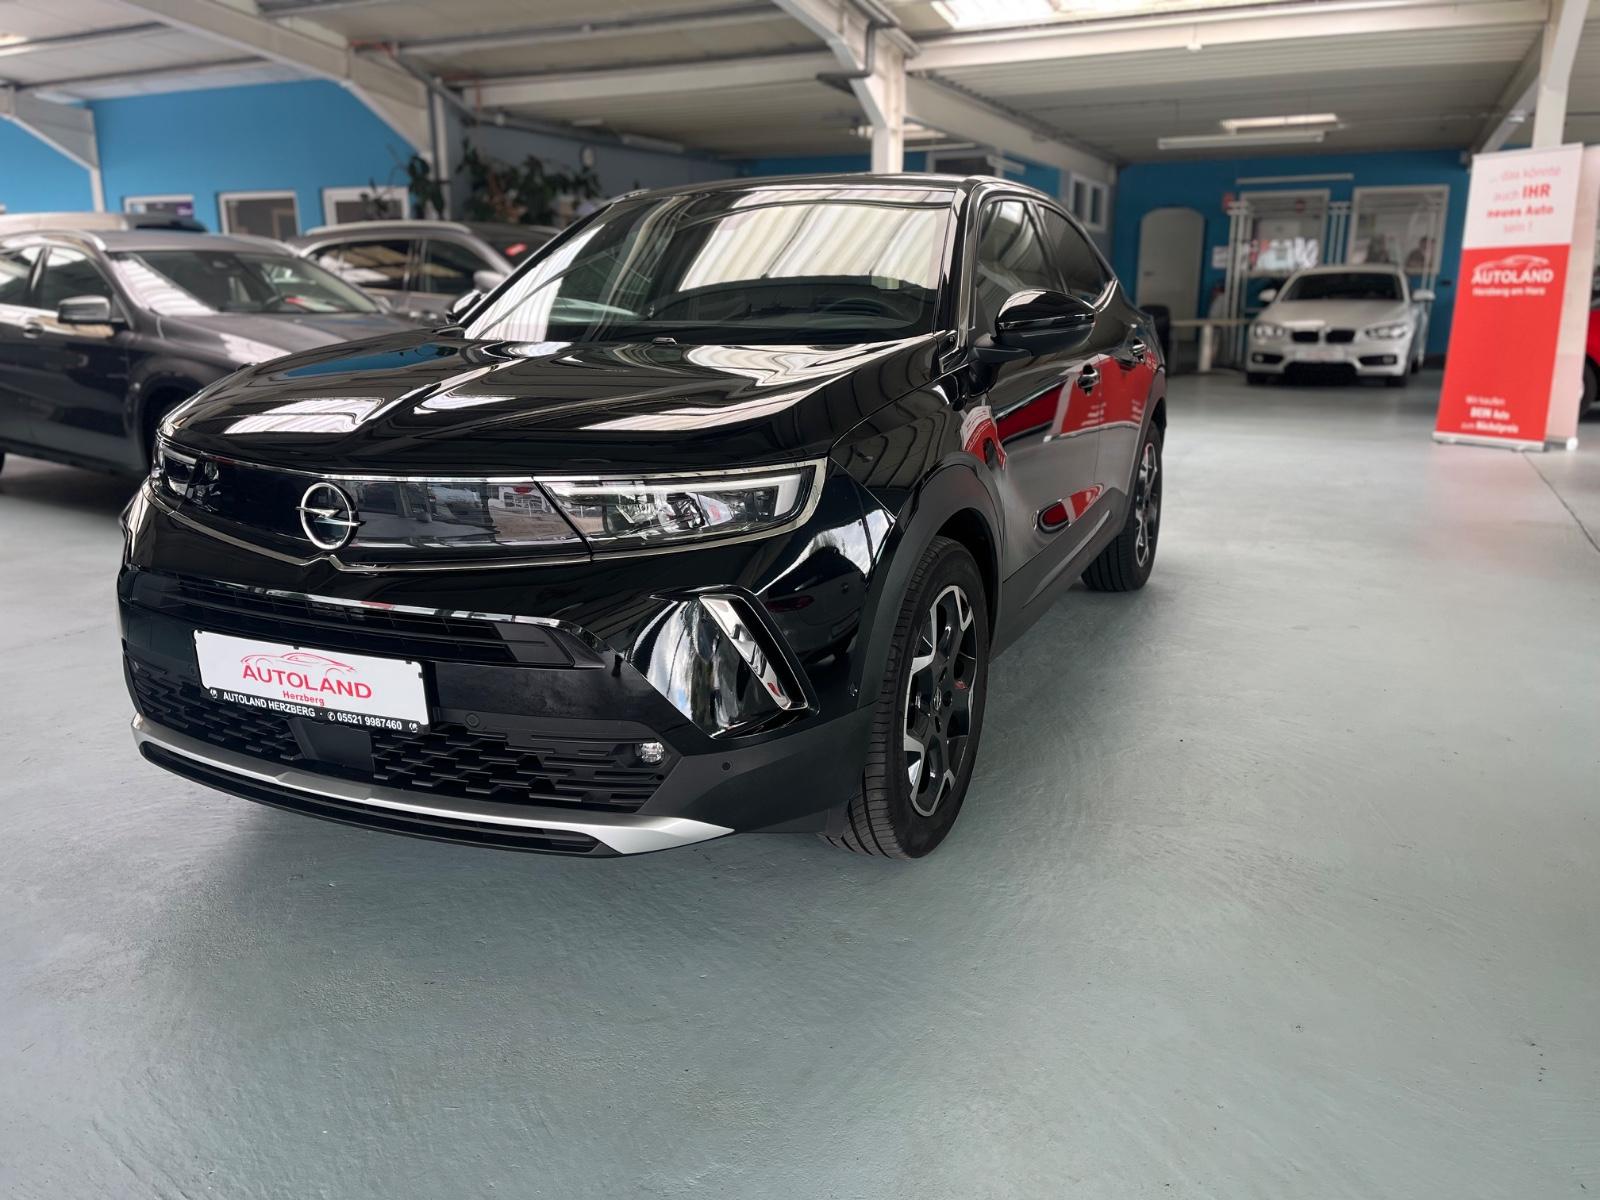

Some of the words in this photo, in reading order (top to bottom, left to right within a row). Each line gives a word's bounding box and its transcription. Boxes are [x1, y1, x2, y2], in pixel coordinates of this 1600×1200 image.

[1522, 183, 1552, 199] IHR
[1486, 207, 1522, 218] neues
[1525, 204, 1554, 216] Auto
[1471, 268, 1554, 285] AUTOLAND
[242, 664, 372, 699] AUTOLAND
[283, 690, 325, 707] Herzberg
[223, 691, 267, 708] AUTOLAND
[268, 700, 316, 717] HERZBERG
[337, 712, 362, 725] 05521
[364, 716, 402, 730] 9987460
